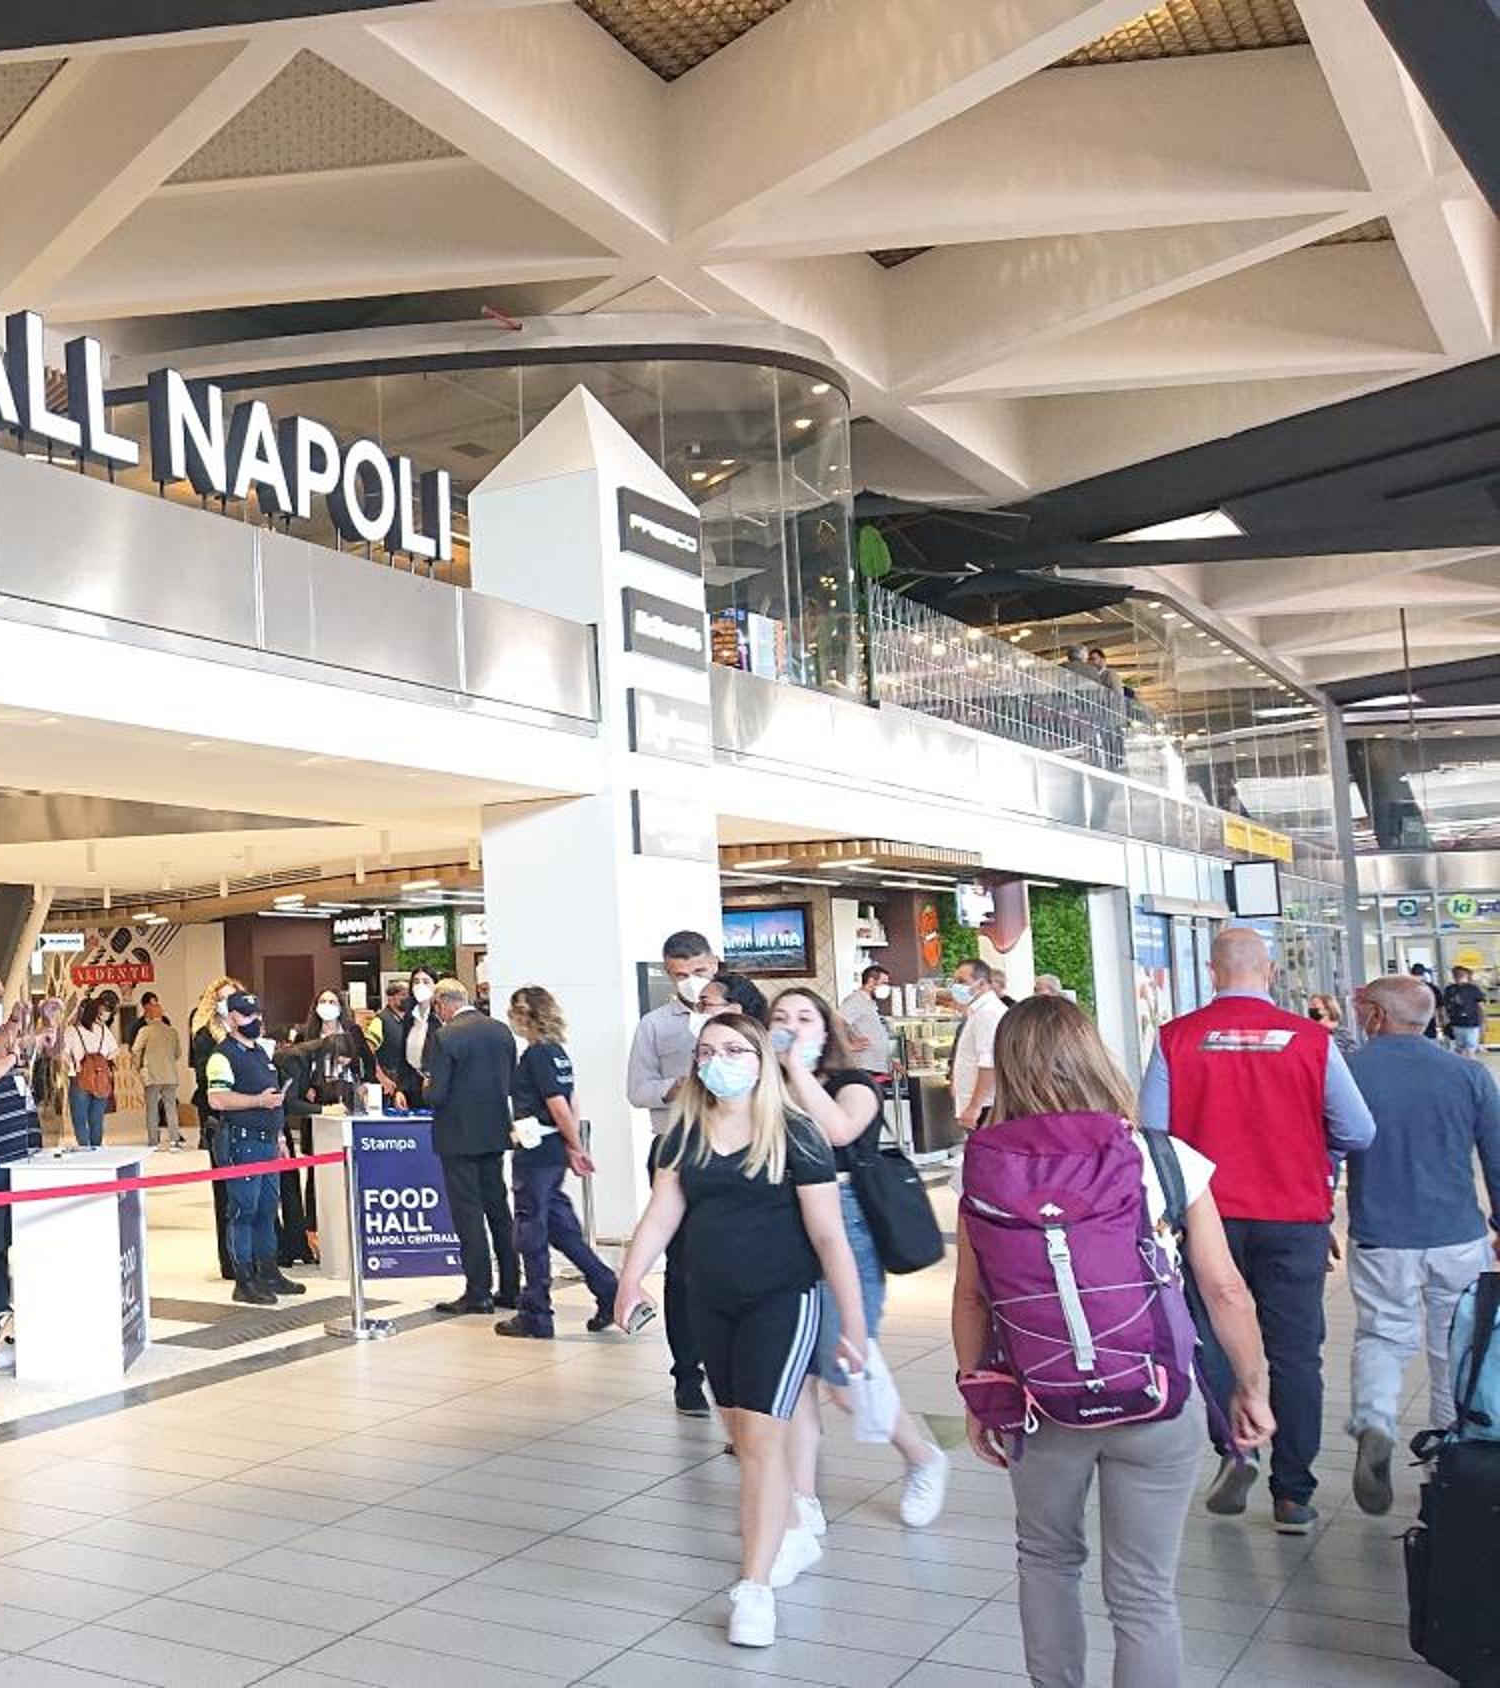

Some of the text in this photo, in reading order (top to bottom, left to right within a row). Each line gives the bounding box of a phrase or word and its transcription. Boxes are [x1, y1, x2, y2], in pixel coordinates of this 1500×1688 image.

[160, 368, 452, 561] NAPOLI
[361, 1137, 417, 1152] Stampa
[363, 1188, 439, 1210] FOOD
[365, 1211, 433, 1233] HALL
[367, 1235, 405, 1246] NAPOLI
